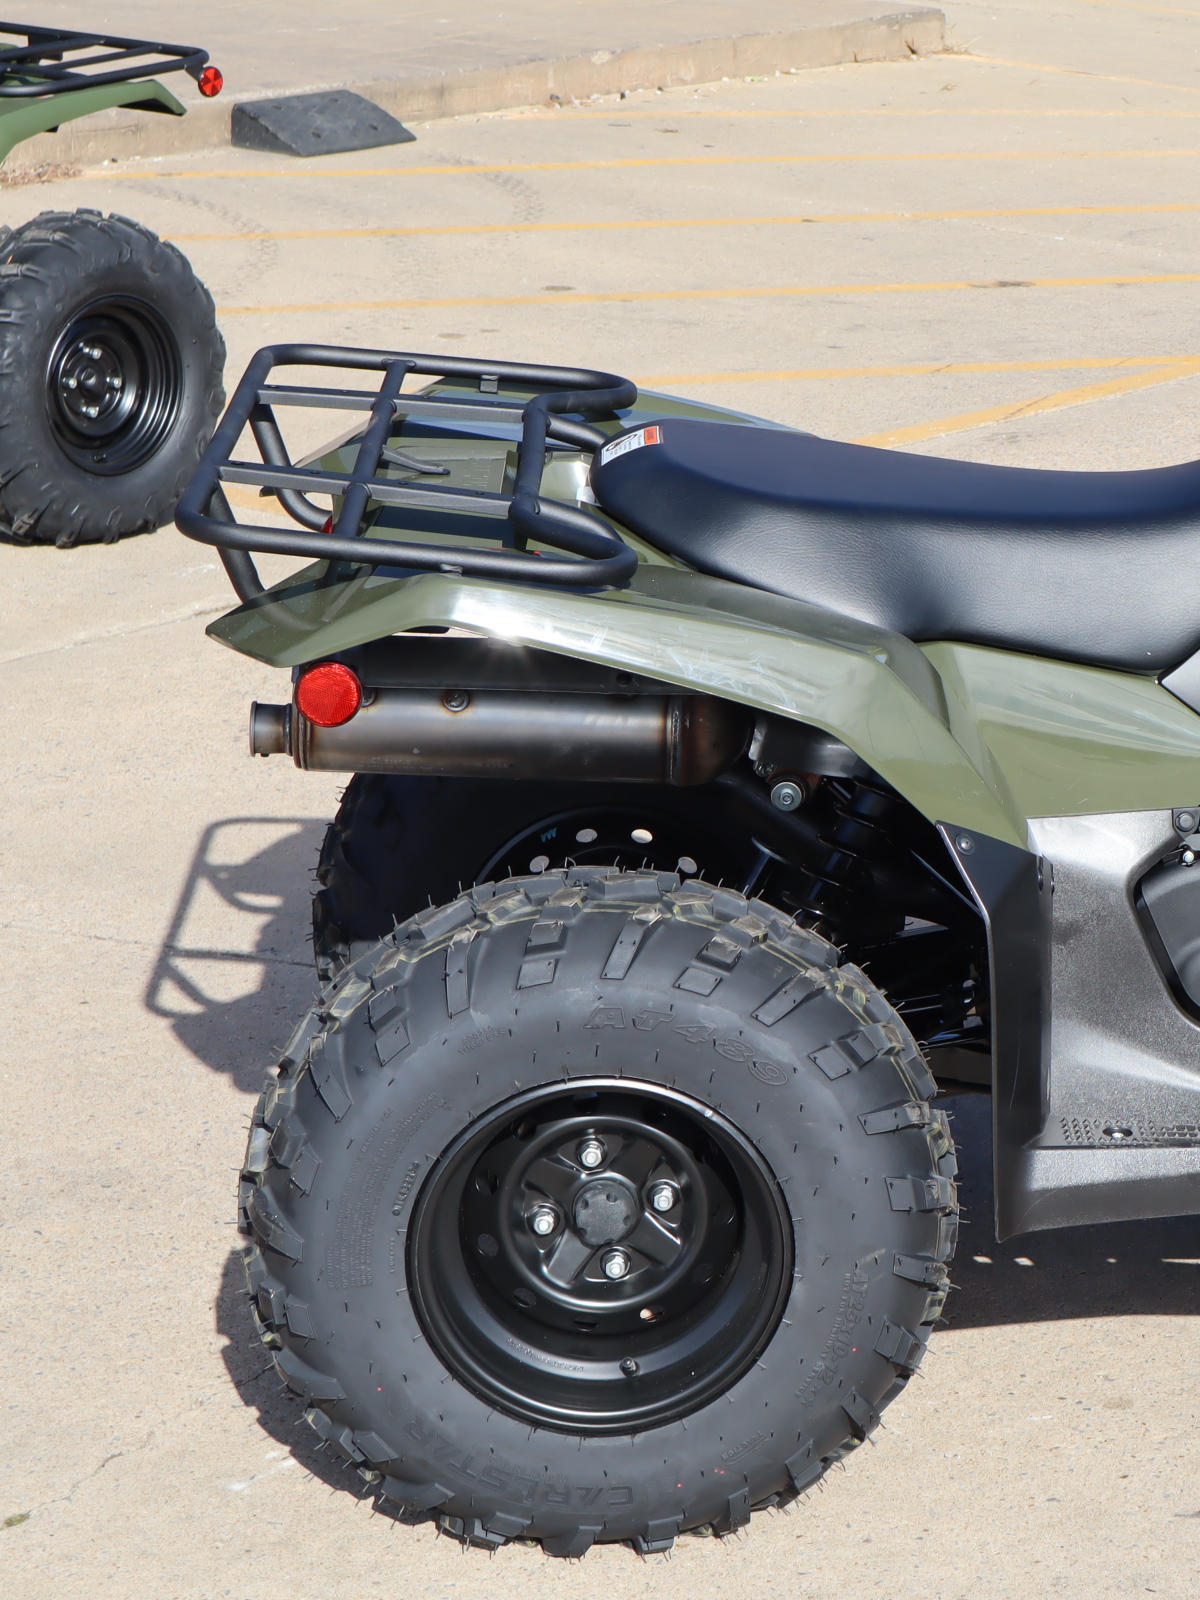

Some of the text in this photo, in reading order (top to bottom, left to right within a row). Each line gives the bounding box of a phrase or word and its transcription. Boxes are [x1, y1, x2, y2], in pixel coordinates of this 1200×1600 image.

[456, 1027, 506, 1057] TUBELESS
[582, 1006, 789, 1087] AT489
[402, 1415, 635, 1508] CARLSTAR
[718, 1427, 765, 1461] TRACTION
